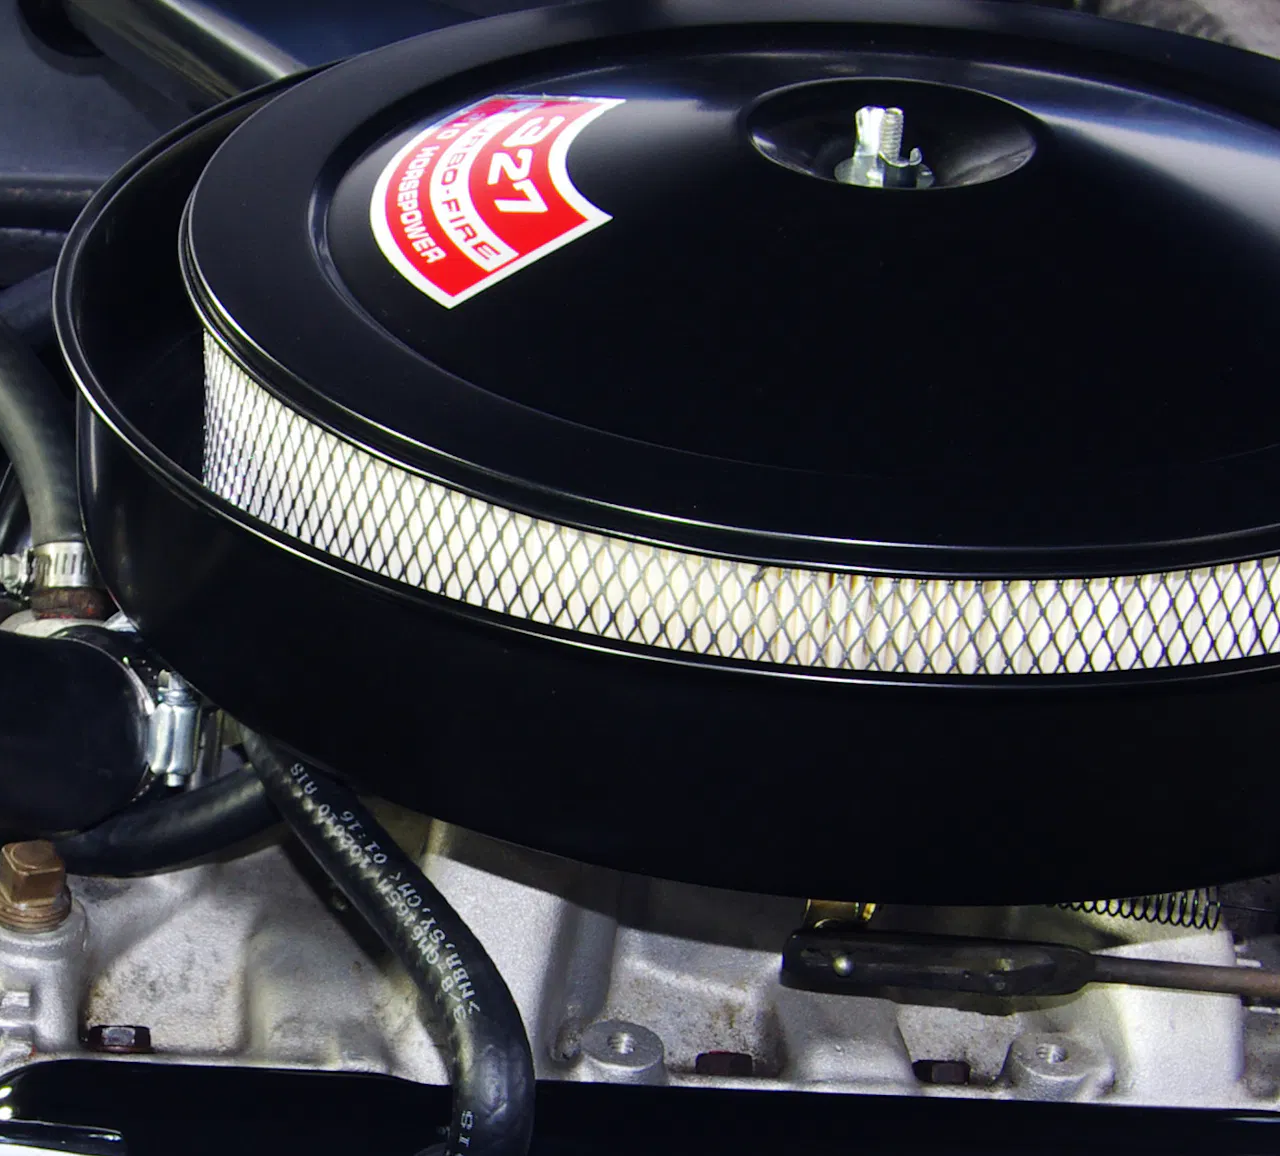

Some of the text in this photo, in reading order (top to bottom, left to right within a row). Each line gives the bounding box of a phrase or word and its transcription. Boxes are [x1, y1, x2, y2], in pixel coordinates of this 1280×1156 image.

[397, 146, 447, 264] HORSEPOWER
[487, 115, 566, 213] 327
[290, 763, 318, 795] AIS
